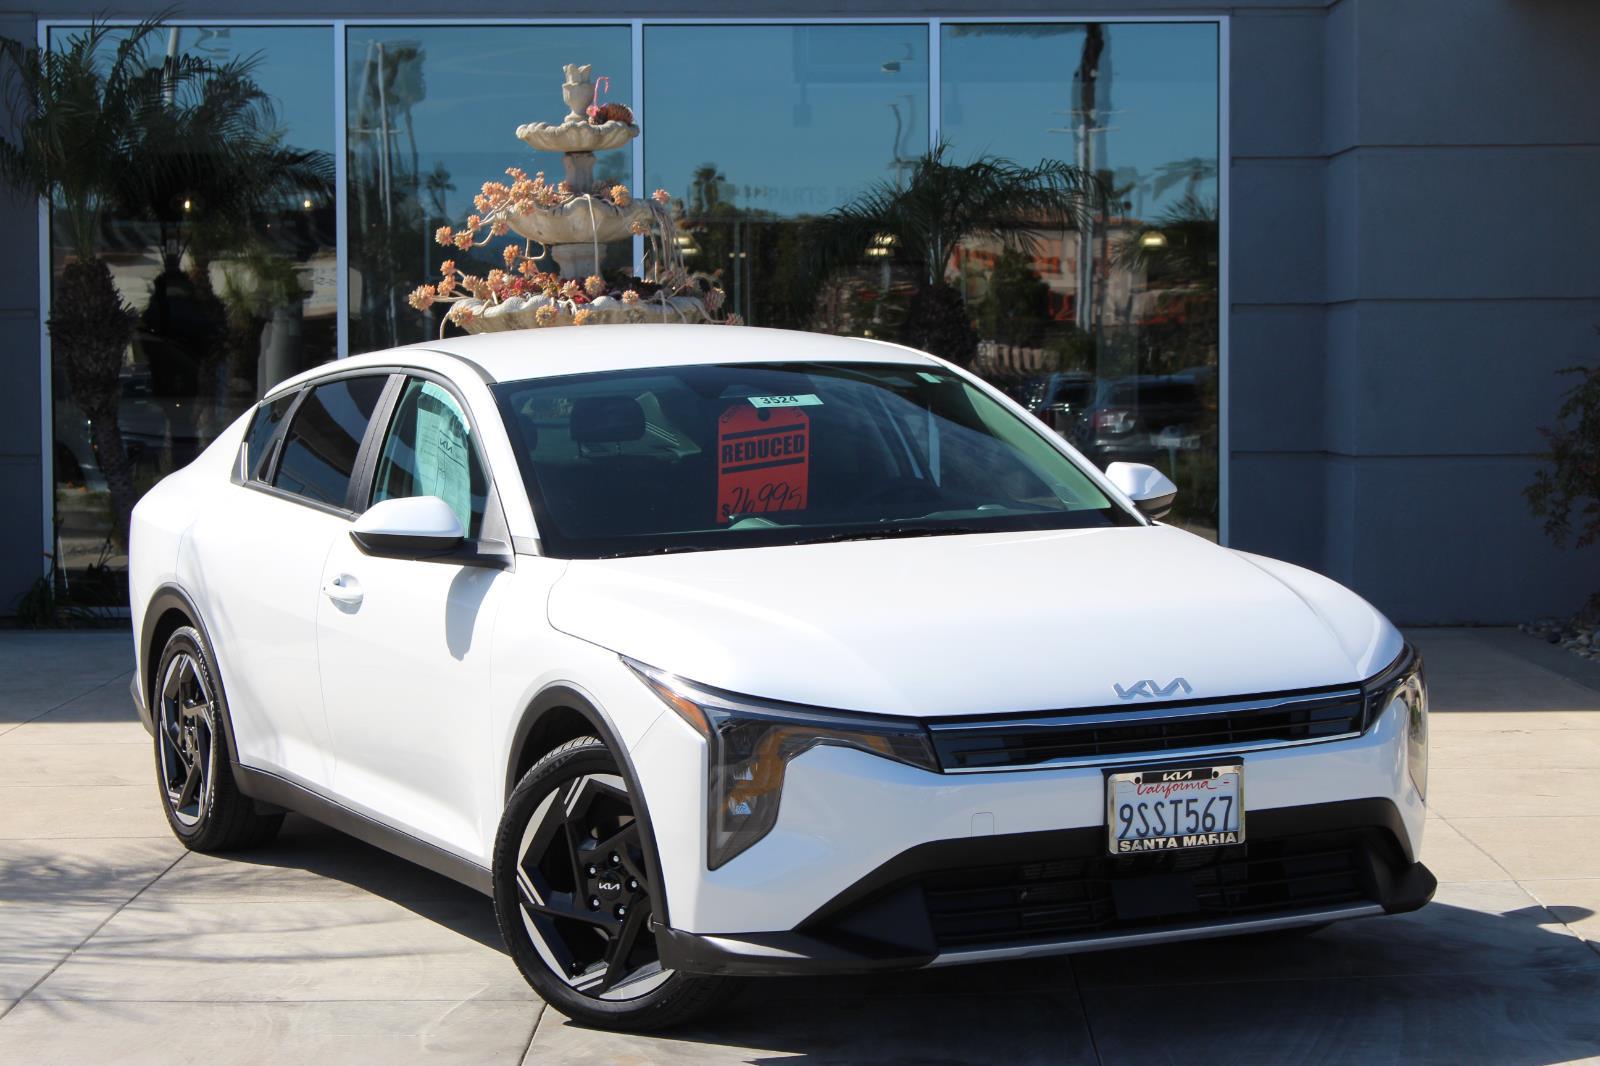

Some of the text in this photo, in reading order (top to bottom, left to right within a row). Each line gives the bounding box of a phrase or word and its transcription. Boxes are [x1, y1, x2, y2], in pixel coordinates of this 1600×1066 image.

[760, 395, 799, 404] 3524
[721, 434, 805, 464] REDUCED
[1112, 677, 1193, 700] KIA
[1162, 770, 1193, 781] KIA
[1136, 780, 1217, 799] California
[1118, 796, 1233, 839] 9SST567
[1119, 832, 1237, 852] SANTA MARIA
[598, 882, 620, 890] KIA
